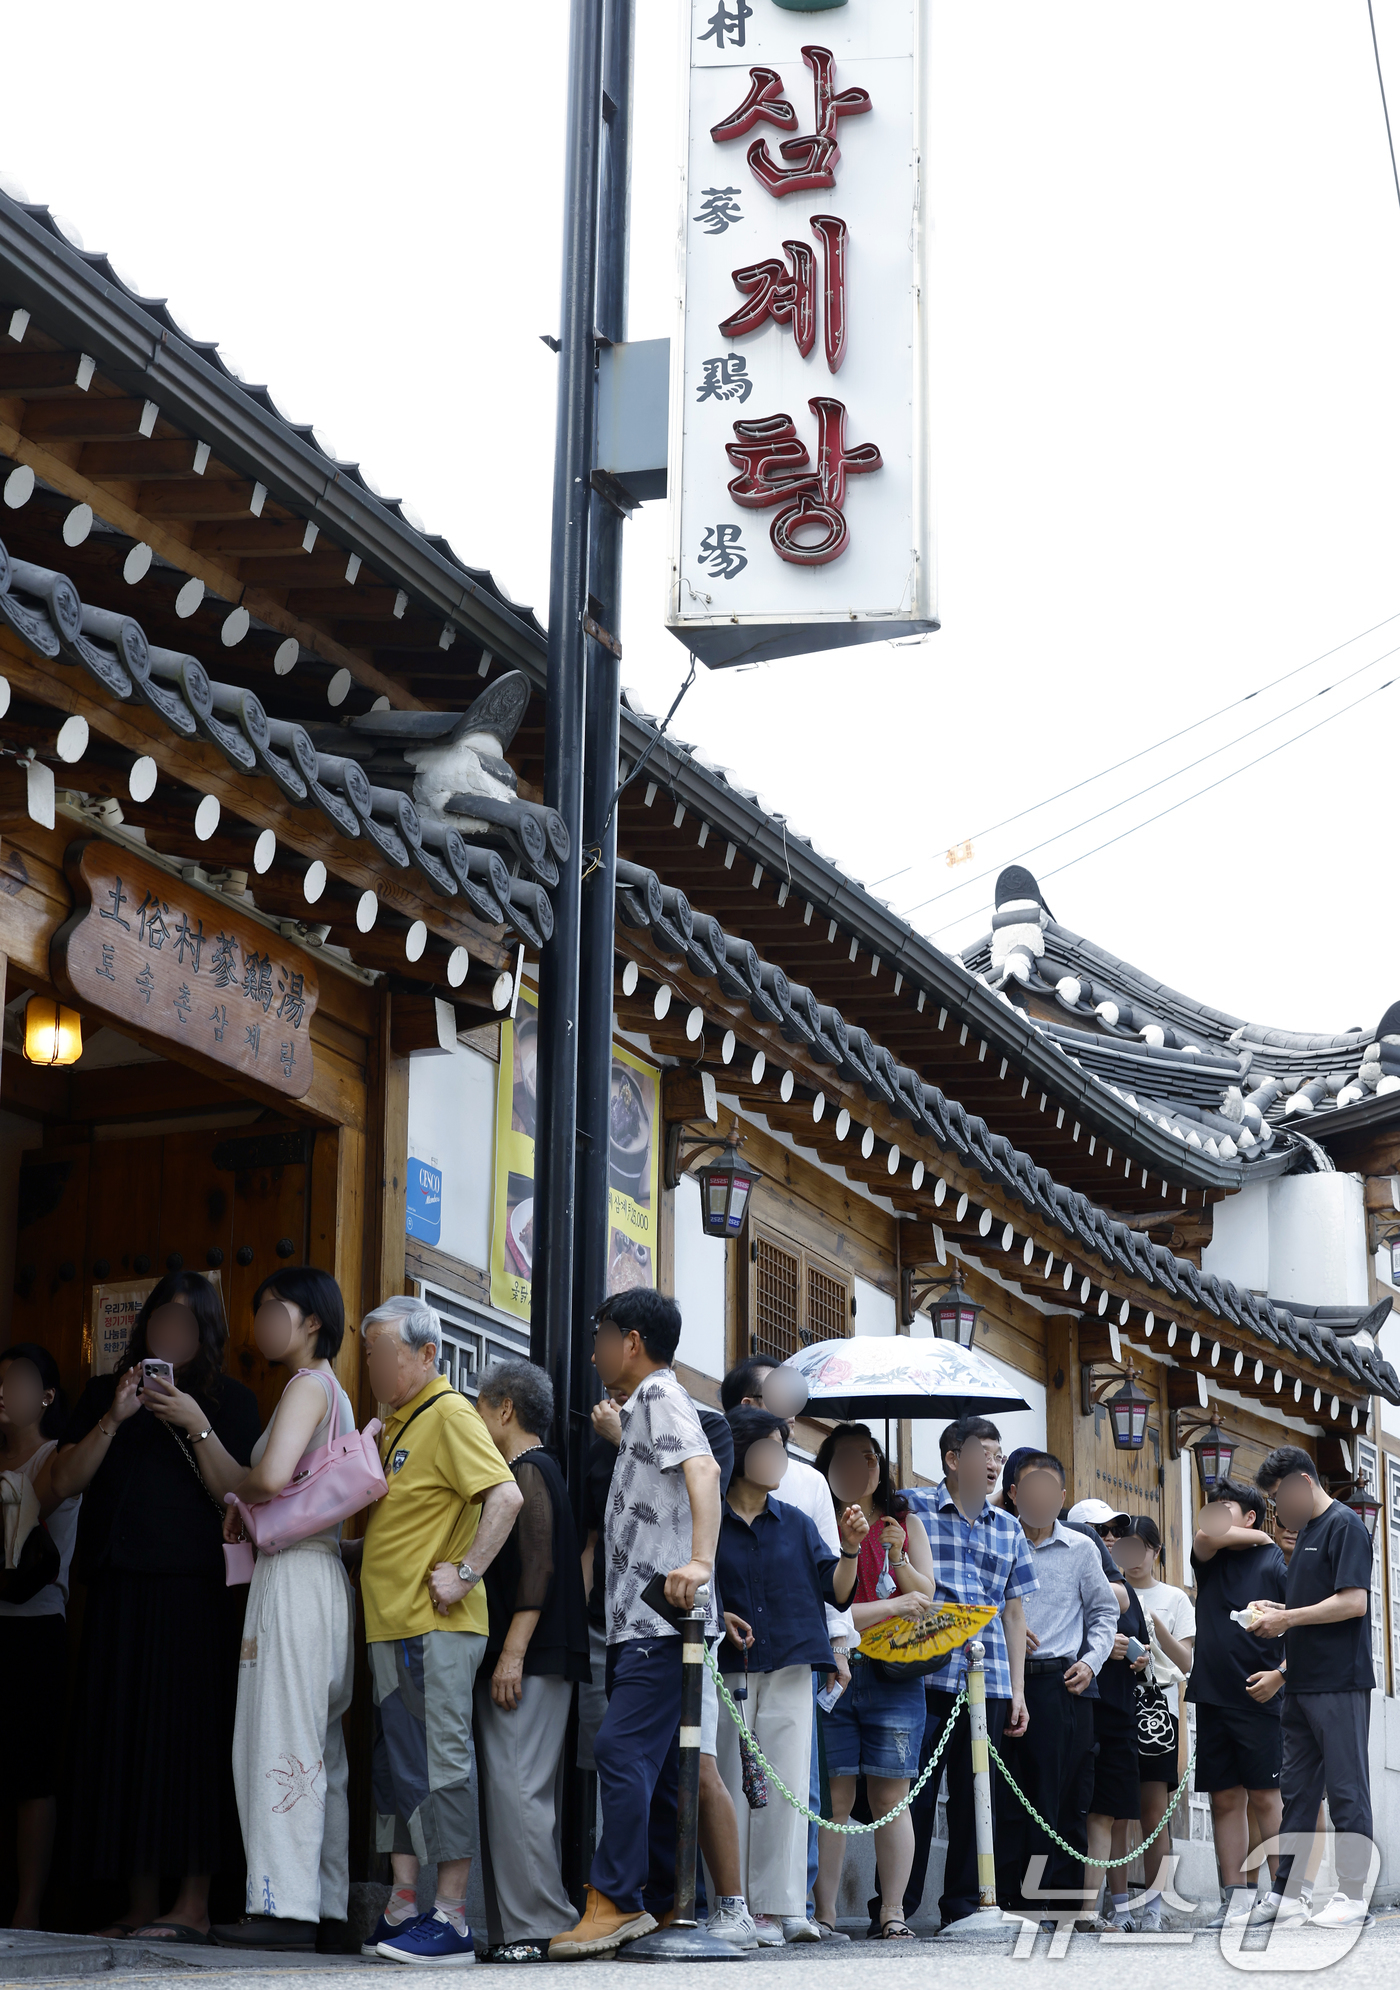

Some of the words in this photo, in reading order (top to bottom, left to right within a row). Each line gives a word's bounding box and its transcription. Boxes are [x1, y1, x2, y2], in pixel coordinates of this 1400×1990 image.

[709, 45, 884, 566] 삼계탕
[419, 1167, 441, 1194] CESCO
[104, 1314, 140, 1328] 정기기부
